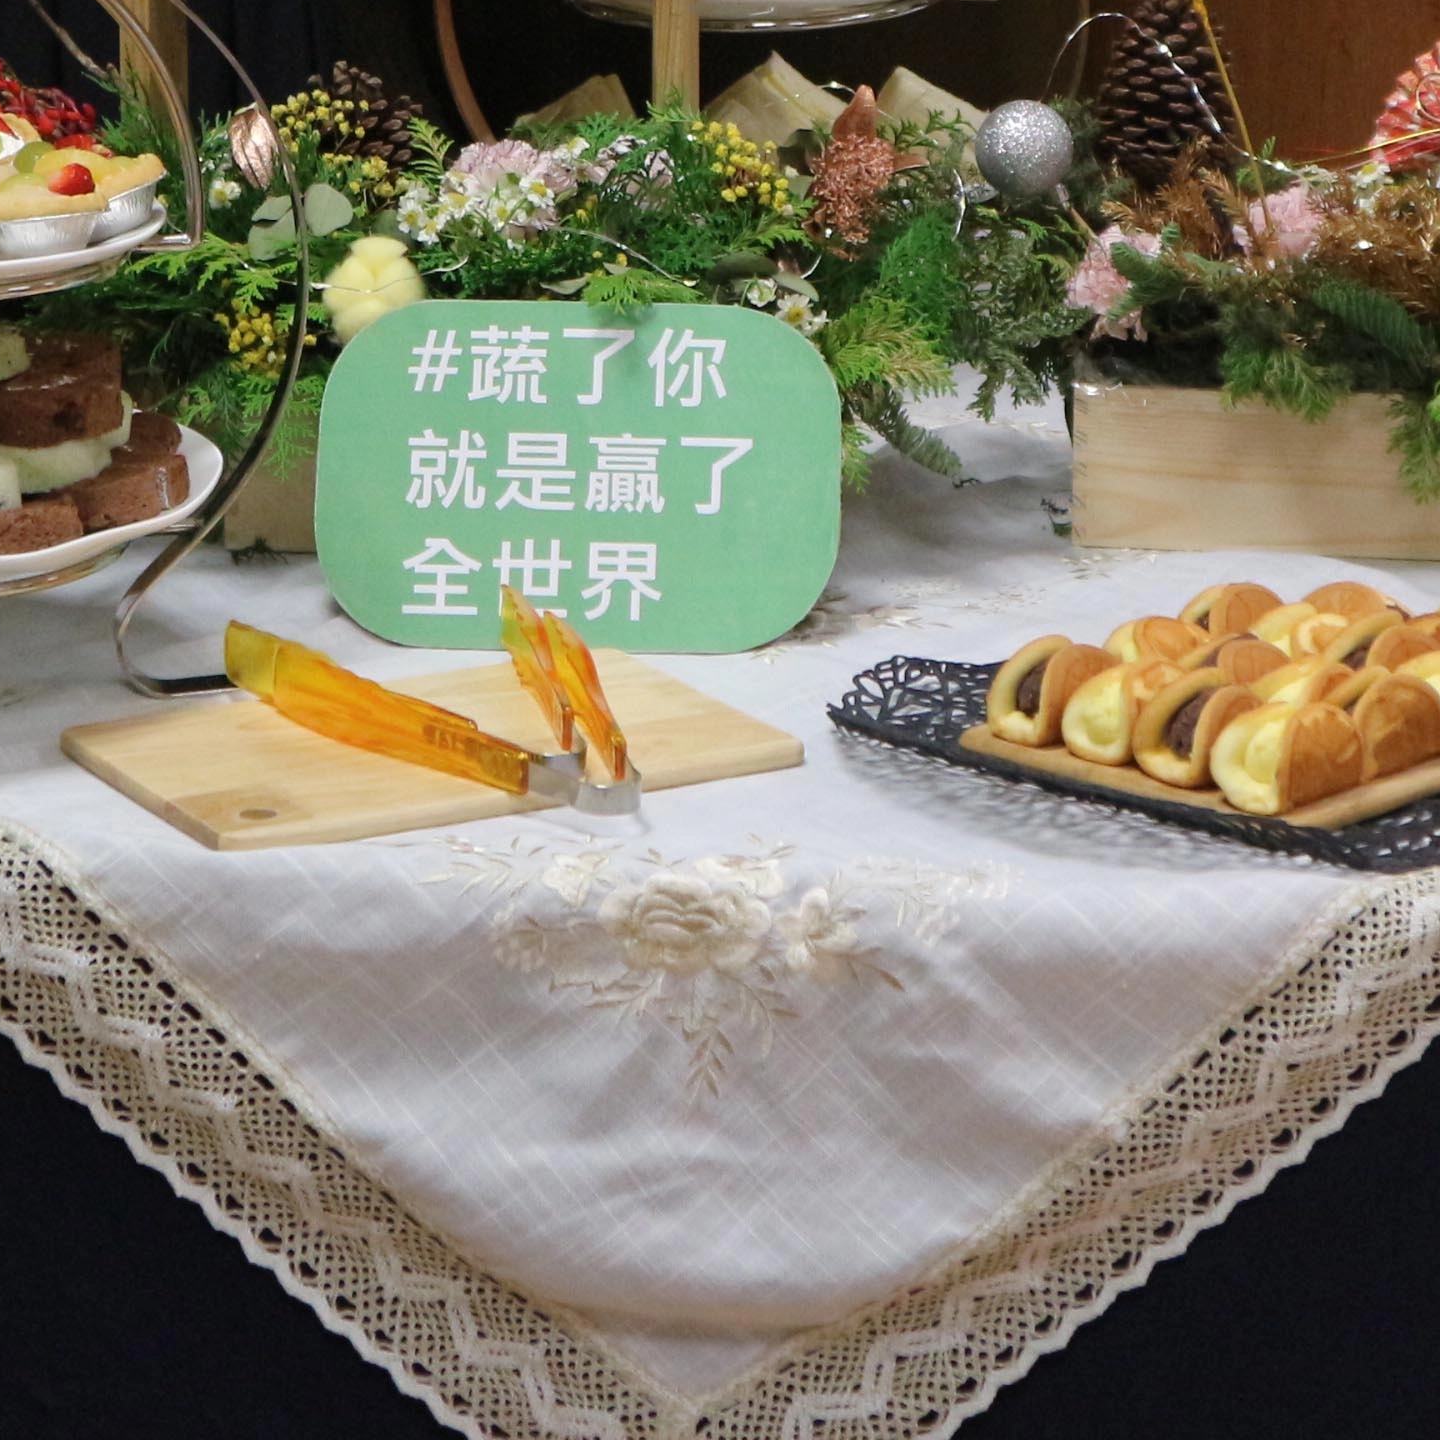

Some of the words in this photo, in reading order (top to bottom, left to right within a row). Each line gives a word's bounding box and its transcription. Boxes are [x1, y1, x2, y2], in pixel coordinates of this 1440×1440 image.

[407, 324, 728, 408] #蔬了你
[405, 428, 754, 515] 就是贏了
[401, 537, 662, 622] 全世界
